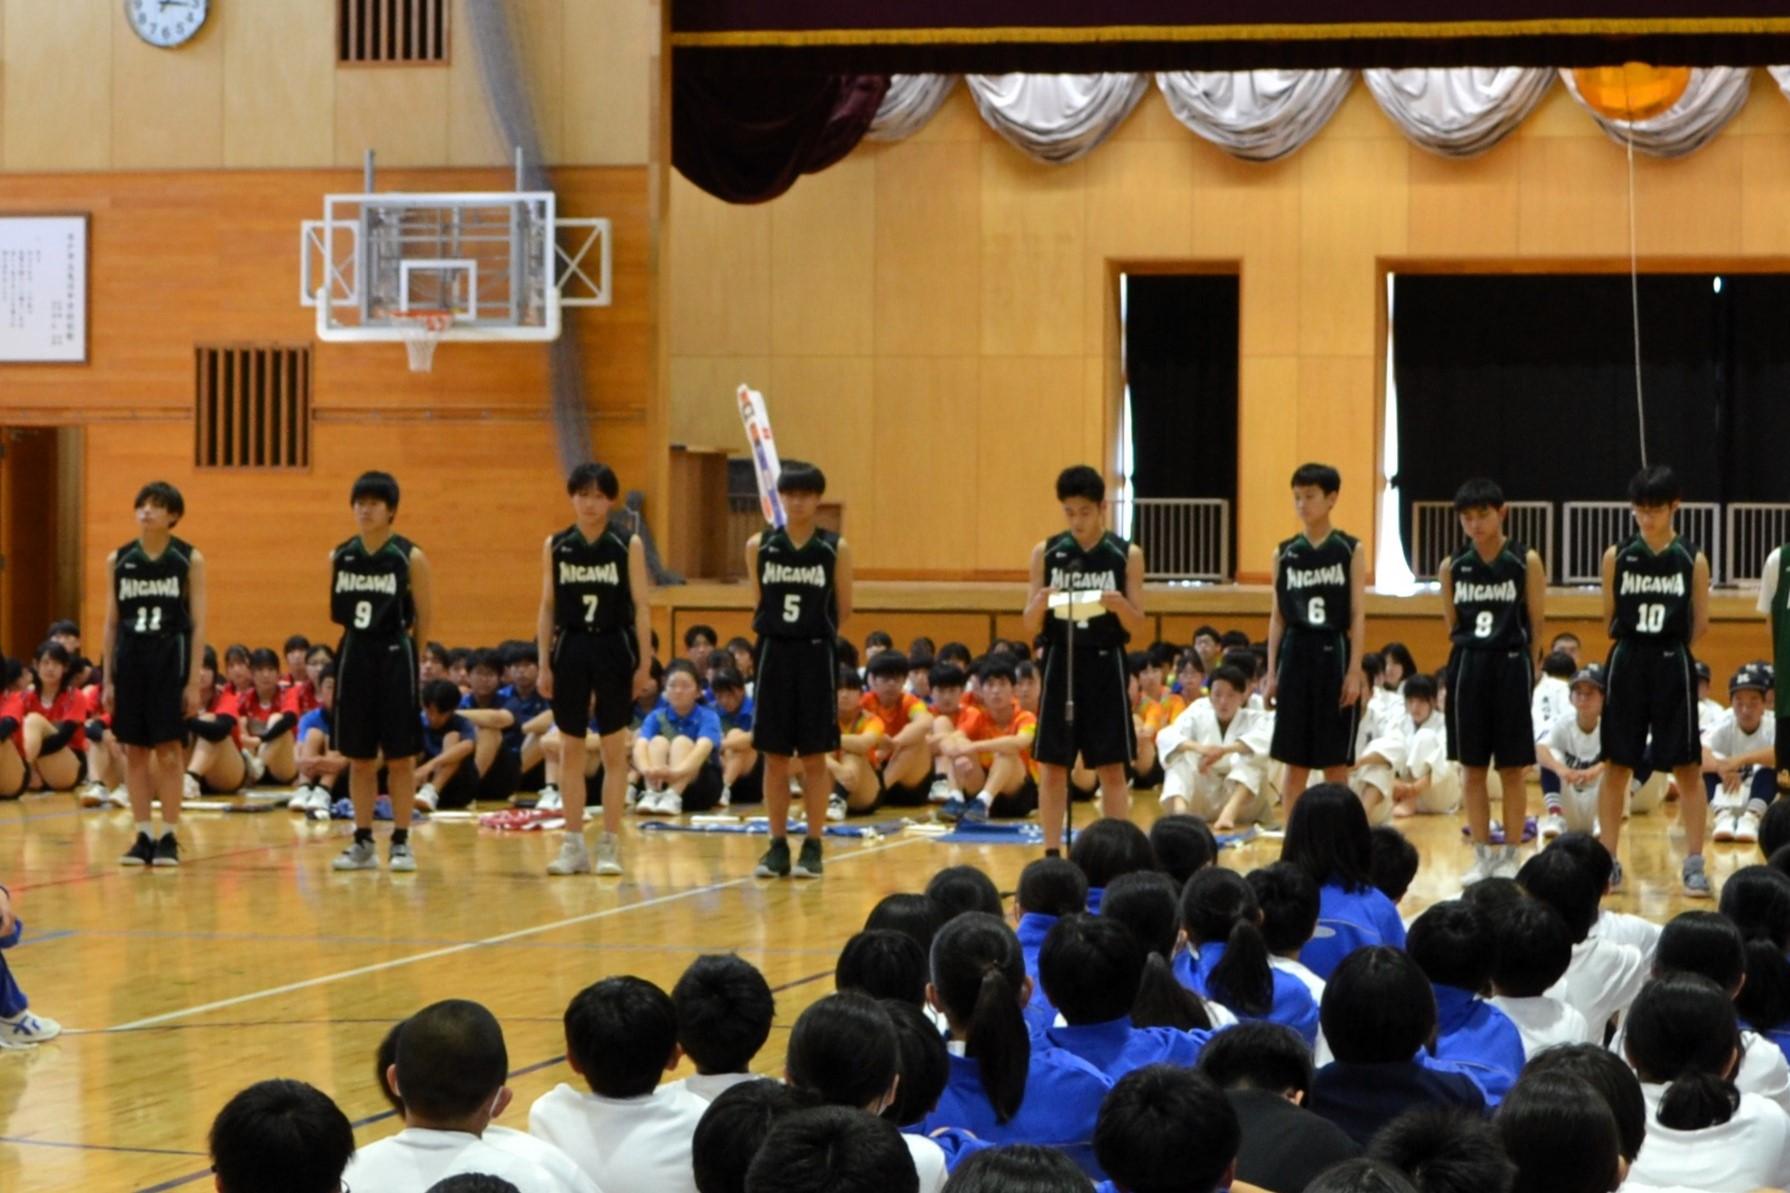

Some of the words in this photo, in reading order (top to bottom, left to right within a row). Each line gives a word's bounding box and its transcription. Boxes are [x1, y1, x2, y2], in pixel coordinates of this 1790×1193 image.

[762, 561, 825, 587] MIGAWA
[1050, 567, 1116, 590] MIGAWA
[1620, 570, 1684, 597] MIGAWA
[1453, 579, 1516, 604] MIGAWA
[134, 606, 162, 632] 11
[354, 601, 372, 629] 9
[582, 594, 598, 622] 7
[783, 593, 801, 622] 5
[1308, 596, 1325, 624] 6
[1635, 603, 1665, 633] 10
[1474, 611, 1493, 637] 8
